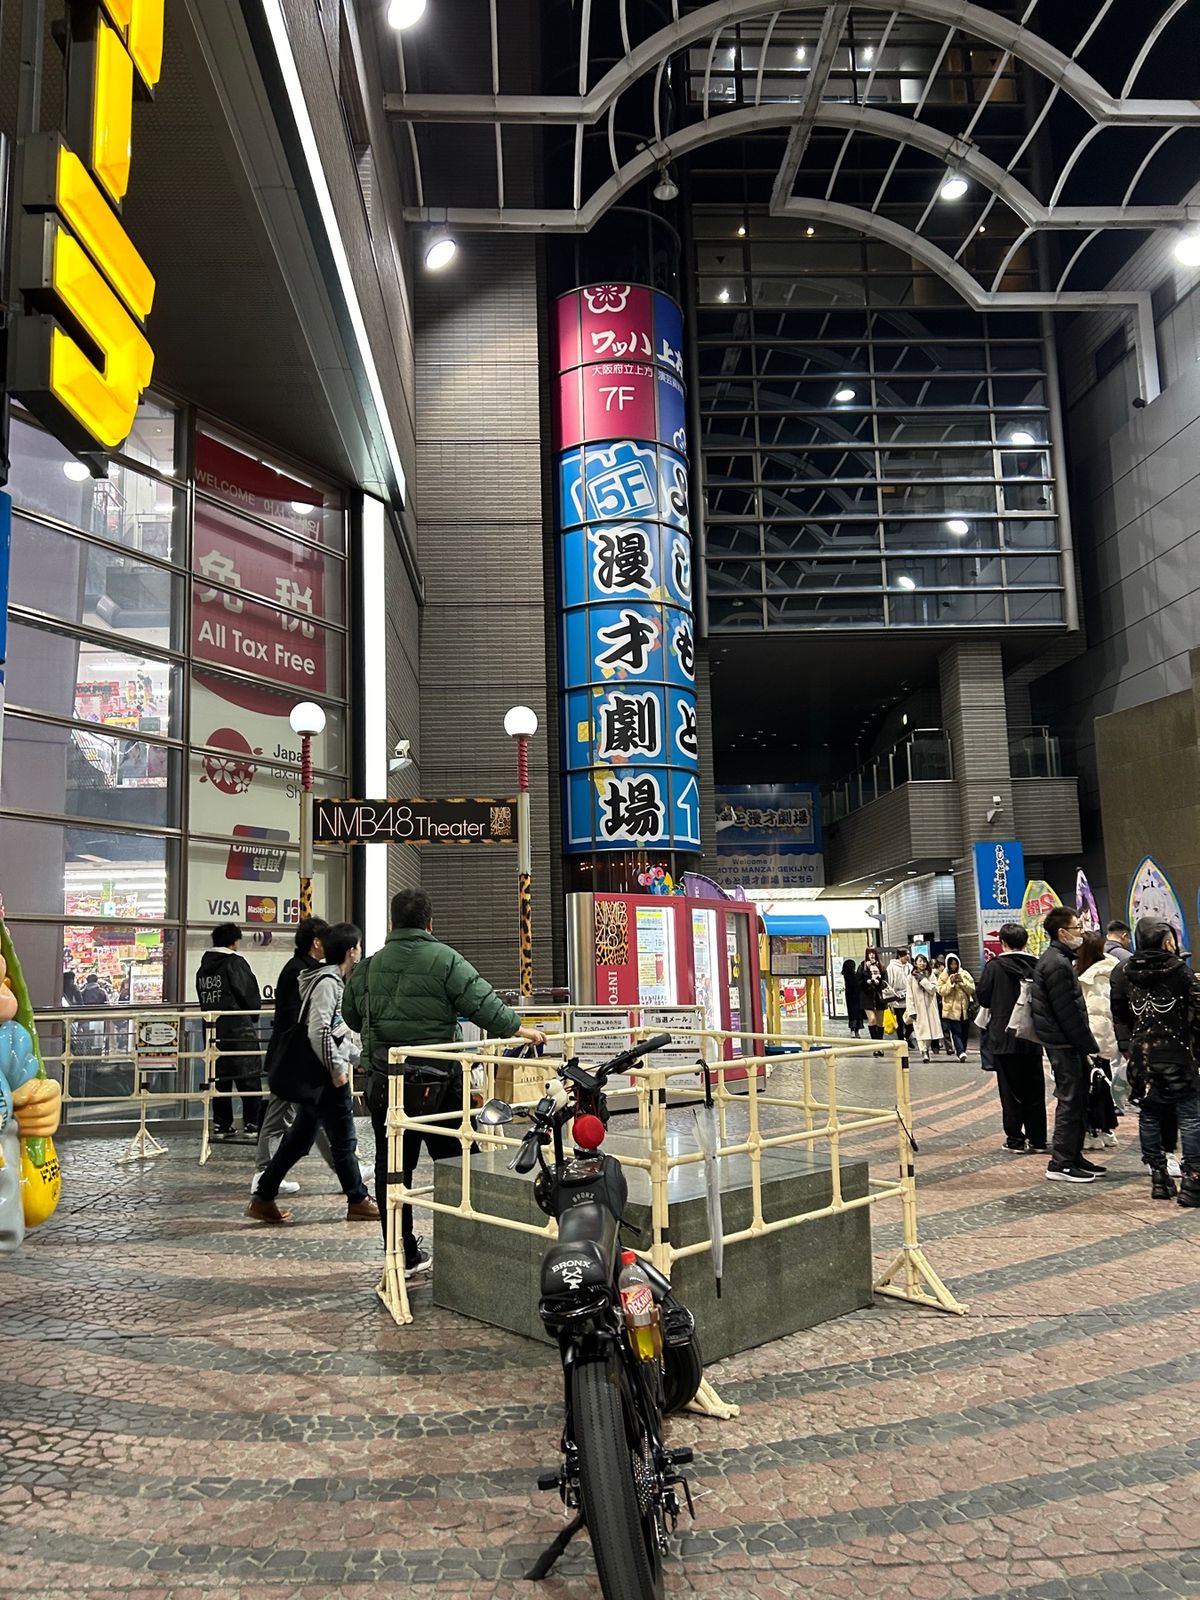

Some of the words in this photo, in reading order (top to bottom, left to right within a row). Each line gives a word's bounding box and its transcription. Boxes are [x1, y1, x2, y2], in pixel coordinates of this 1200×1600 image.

[599, 386, 635, 412] 7F
[195, 467, 256, 506] WELCOME
[595, 467, 645, 515] 5F
[199, 550, 315, 640] 免税
[198, 620, 226, 649] All
[232, 630, 268, 662] Tax
[274, 643, 316, 676] Free
[599, 534, 661, 838] 漫才劇場
[273, 744, 302, 763] Japa
[319, 806, 414, 837] NMB48
[415, 816, 485, 836] Theater
[208, 899, 240, 916] VISA
[247, 905, 275, 914] MasterCard
[572, 1191, 594, 1202] BRONX
[551, 1259, 593, 1274] BRONX
